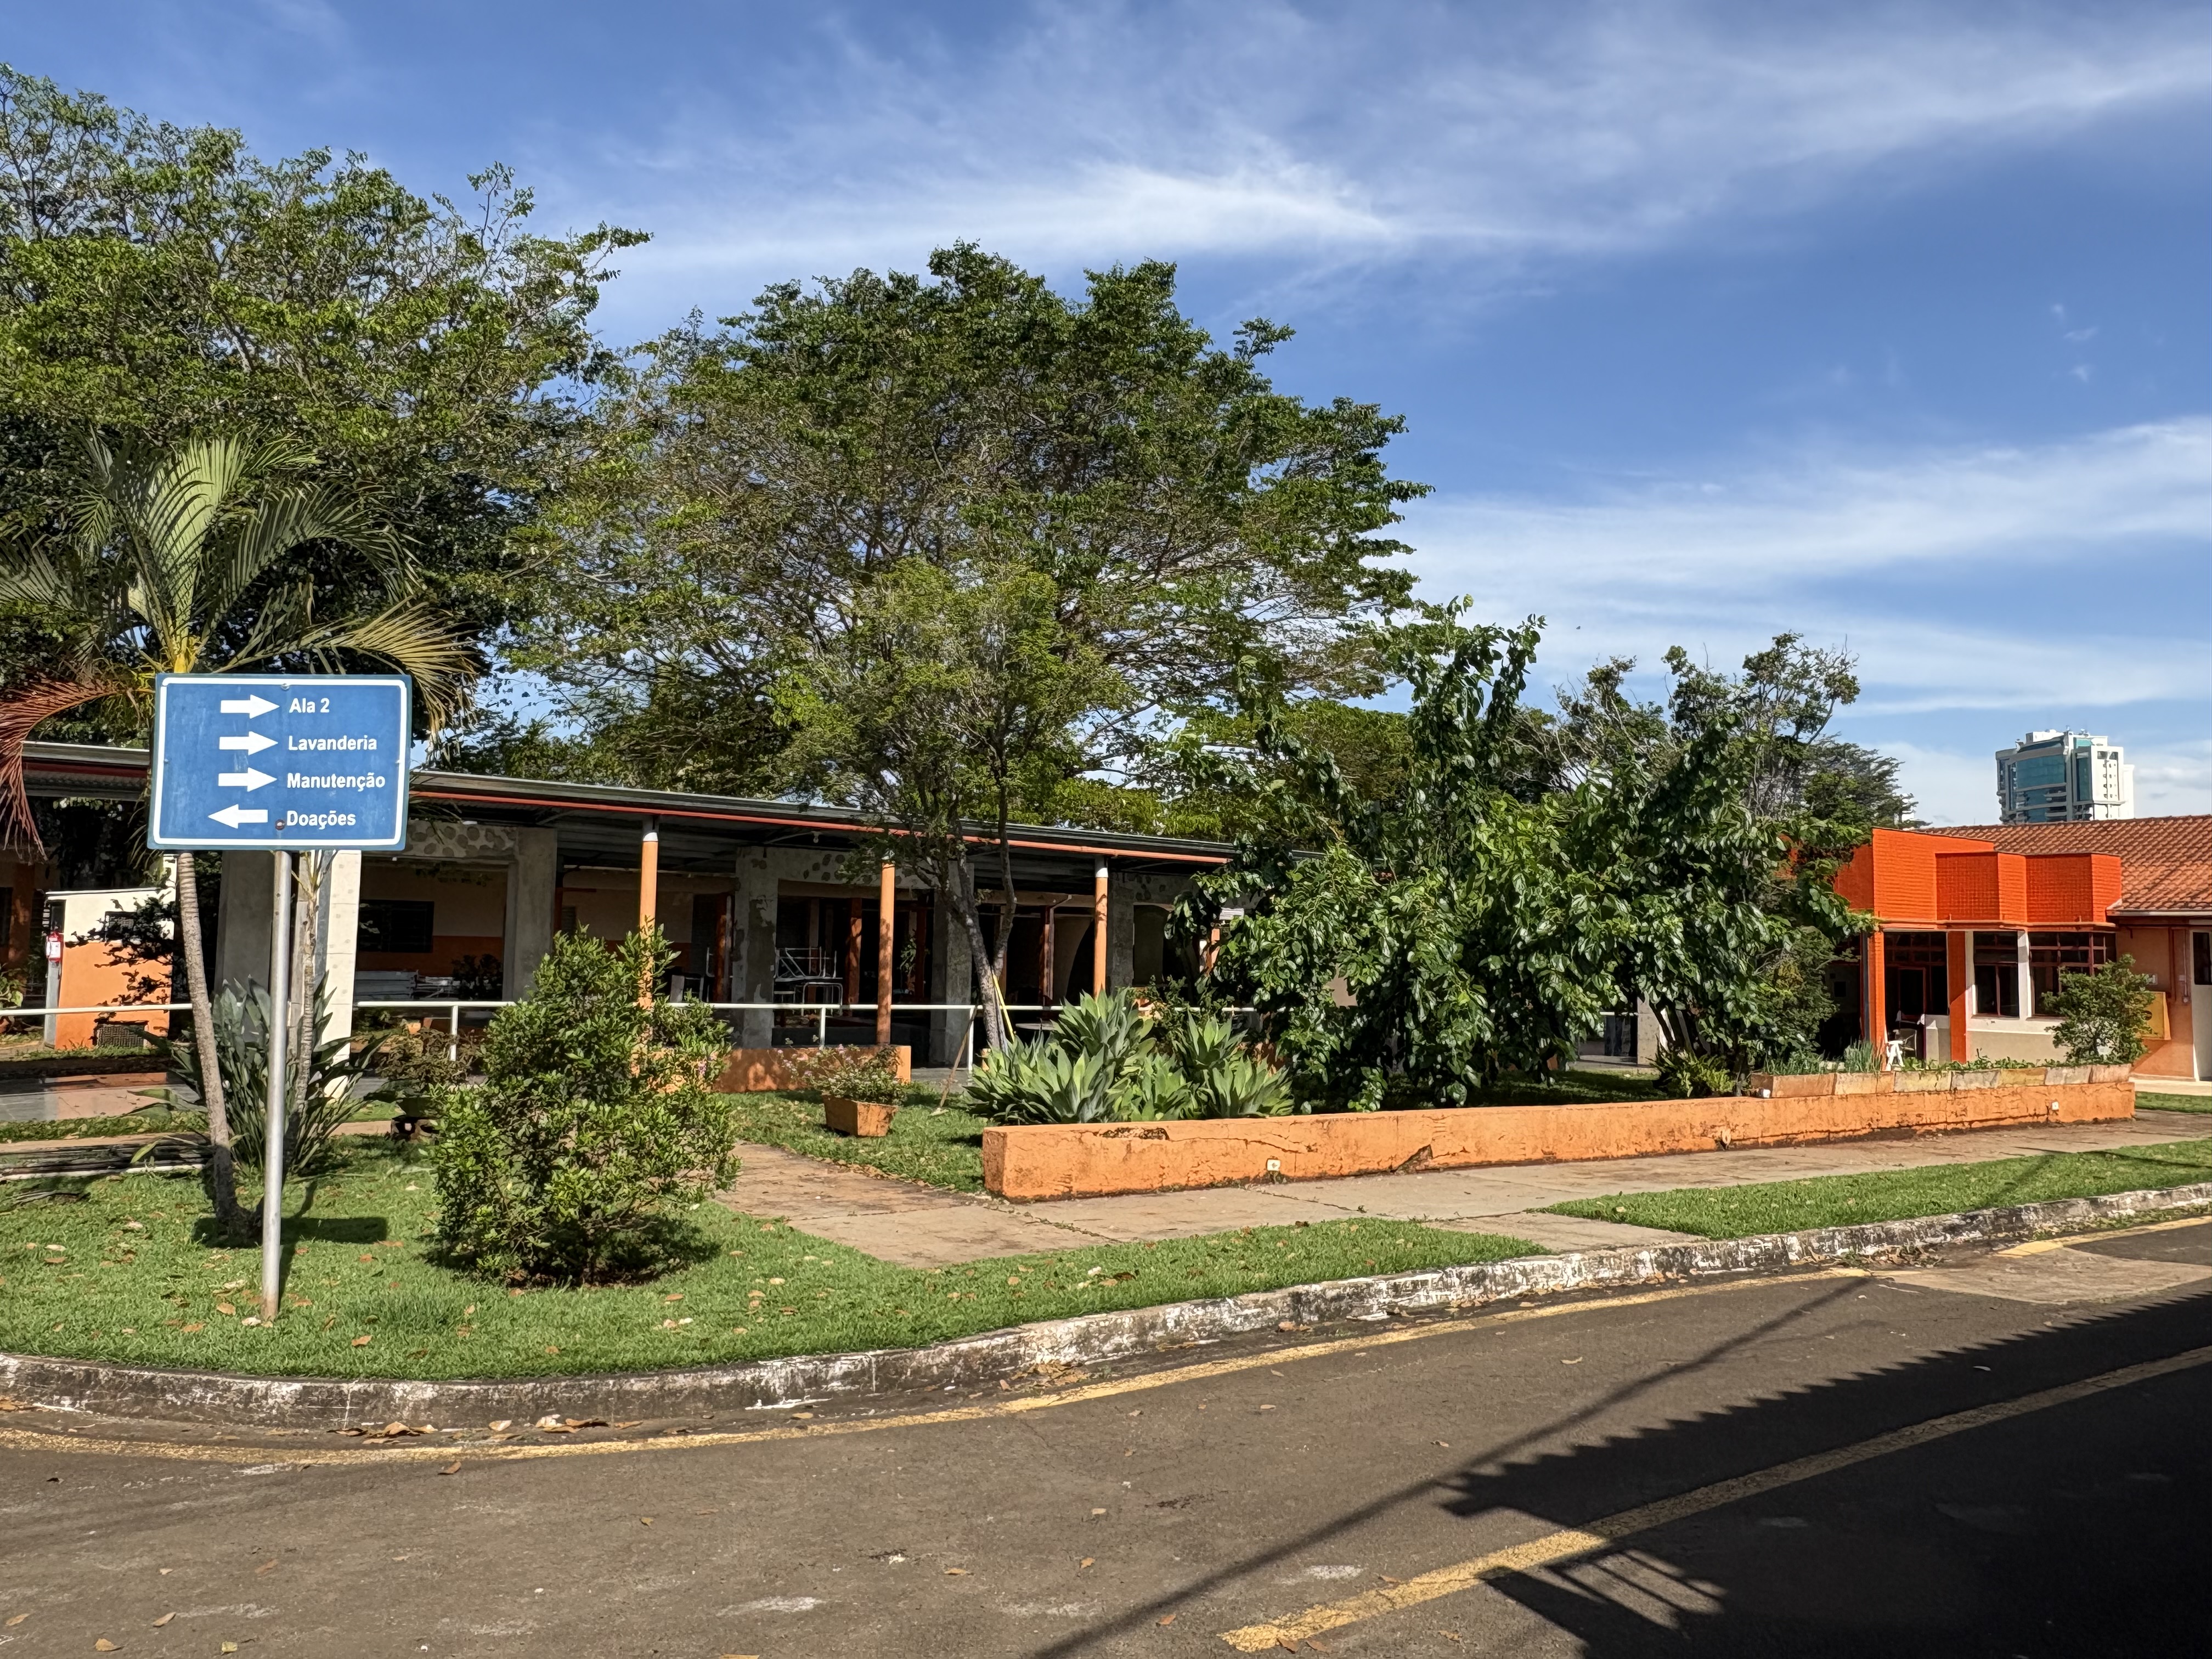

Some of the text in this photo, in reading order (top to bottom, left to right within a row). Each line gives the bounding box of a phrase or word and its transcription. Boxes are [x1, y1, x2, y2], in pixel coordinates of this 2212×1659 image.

[289, 698, 330, 713] Ala 2
[288, 735, 377, 751] Lavanderia
[287, 772, 386, 791] Manutenção
[287, 810, 356, 830] Doações
